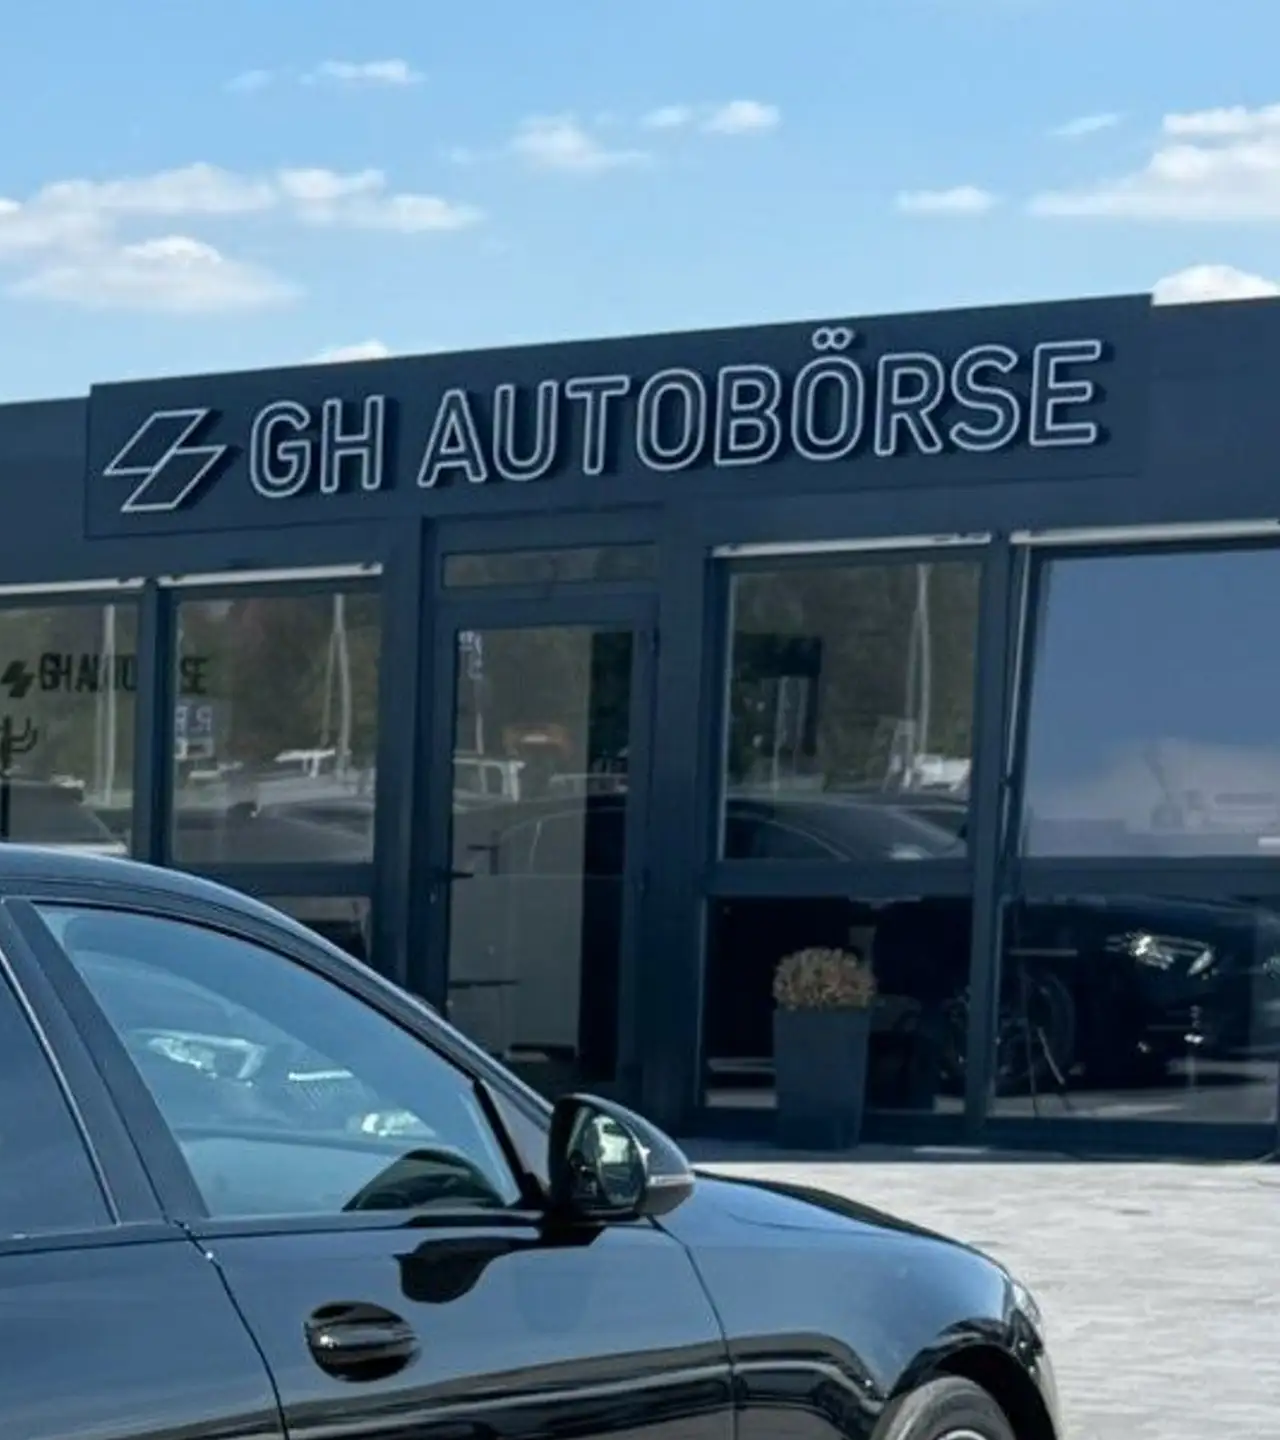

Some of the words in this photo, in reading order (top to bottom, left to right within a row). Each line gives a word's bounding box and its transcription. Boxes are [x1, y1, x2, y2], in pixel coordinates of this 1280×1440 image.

[249, 395, 385, 498] GH
[417, 327, 1102, 488] AUTOBÖRSE
[39, 653, 72, 692] GH
